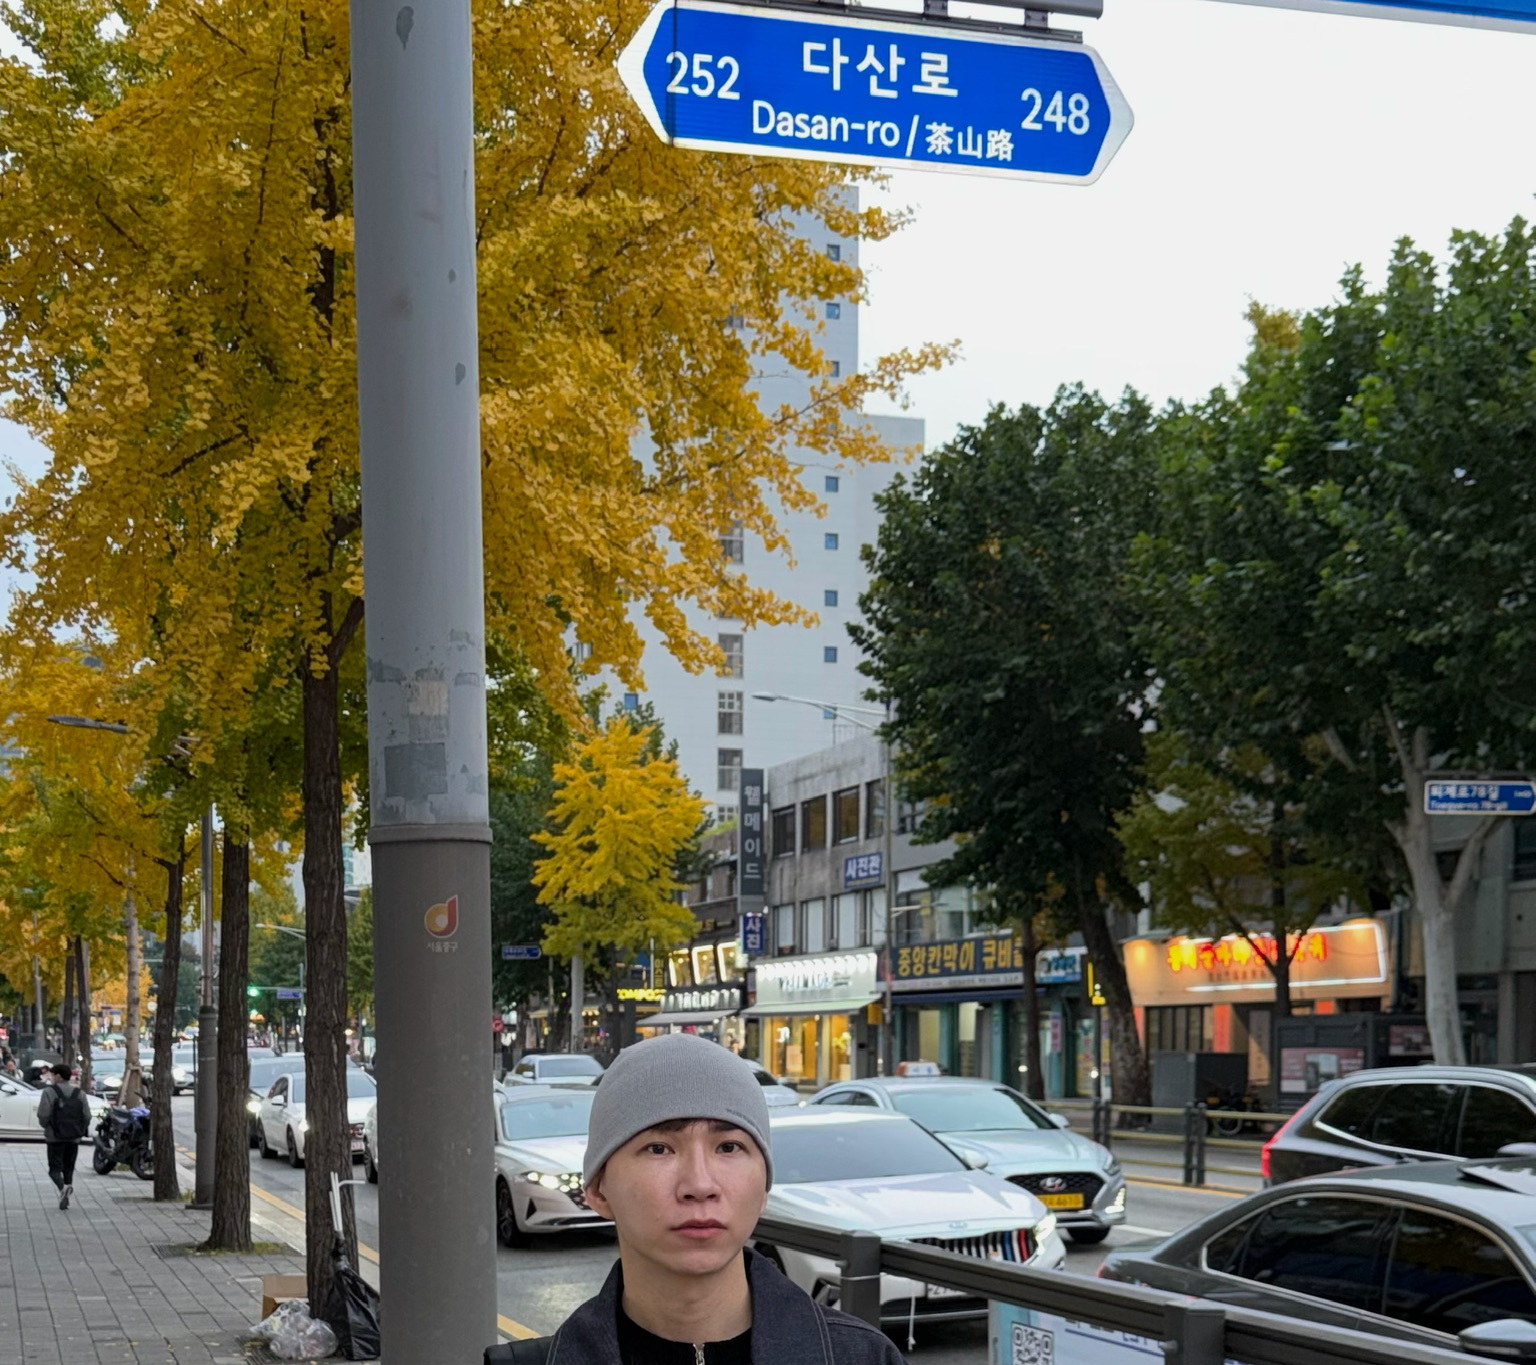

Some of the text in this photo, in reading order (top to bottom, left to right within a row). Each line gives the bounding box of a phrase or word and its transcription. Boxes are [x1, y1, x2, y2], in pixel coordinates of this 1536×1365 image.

[666, 51, 740, 100] 252
[803, 37, 958, 99] 다산로
[752, 99, 900, 147] Dasan-ro
[925, 121, 1015, 162] 茶山路
[1021, 88, 1090, 135] 248
[743, 785, 762, 879] 웰메이드
[846, 856, 880, 880] 사진관
[746, 917, 761, 949] 사진
[898, 940, 975, 976] 중앙칸막이
